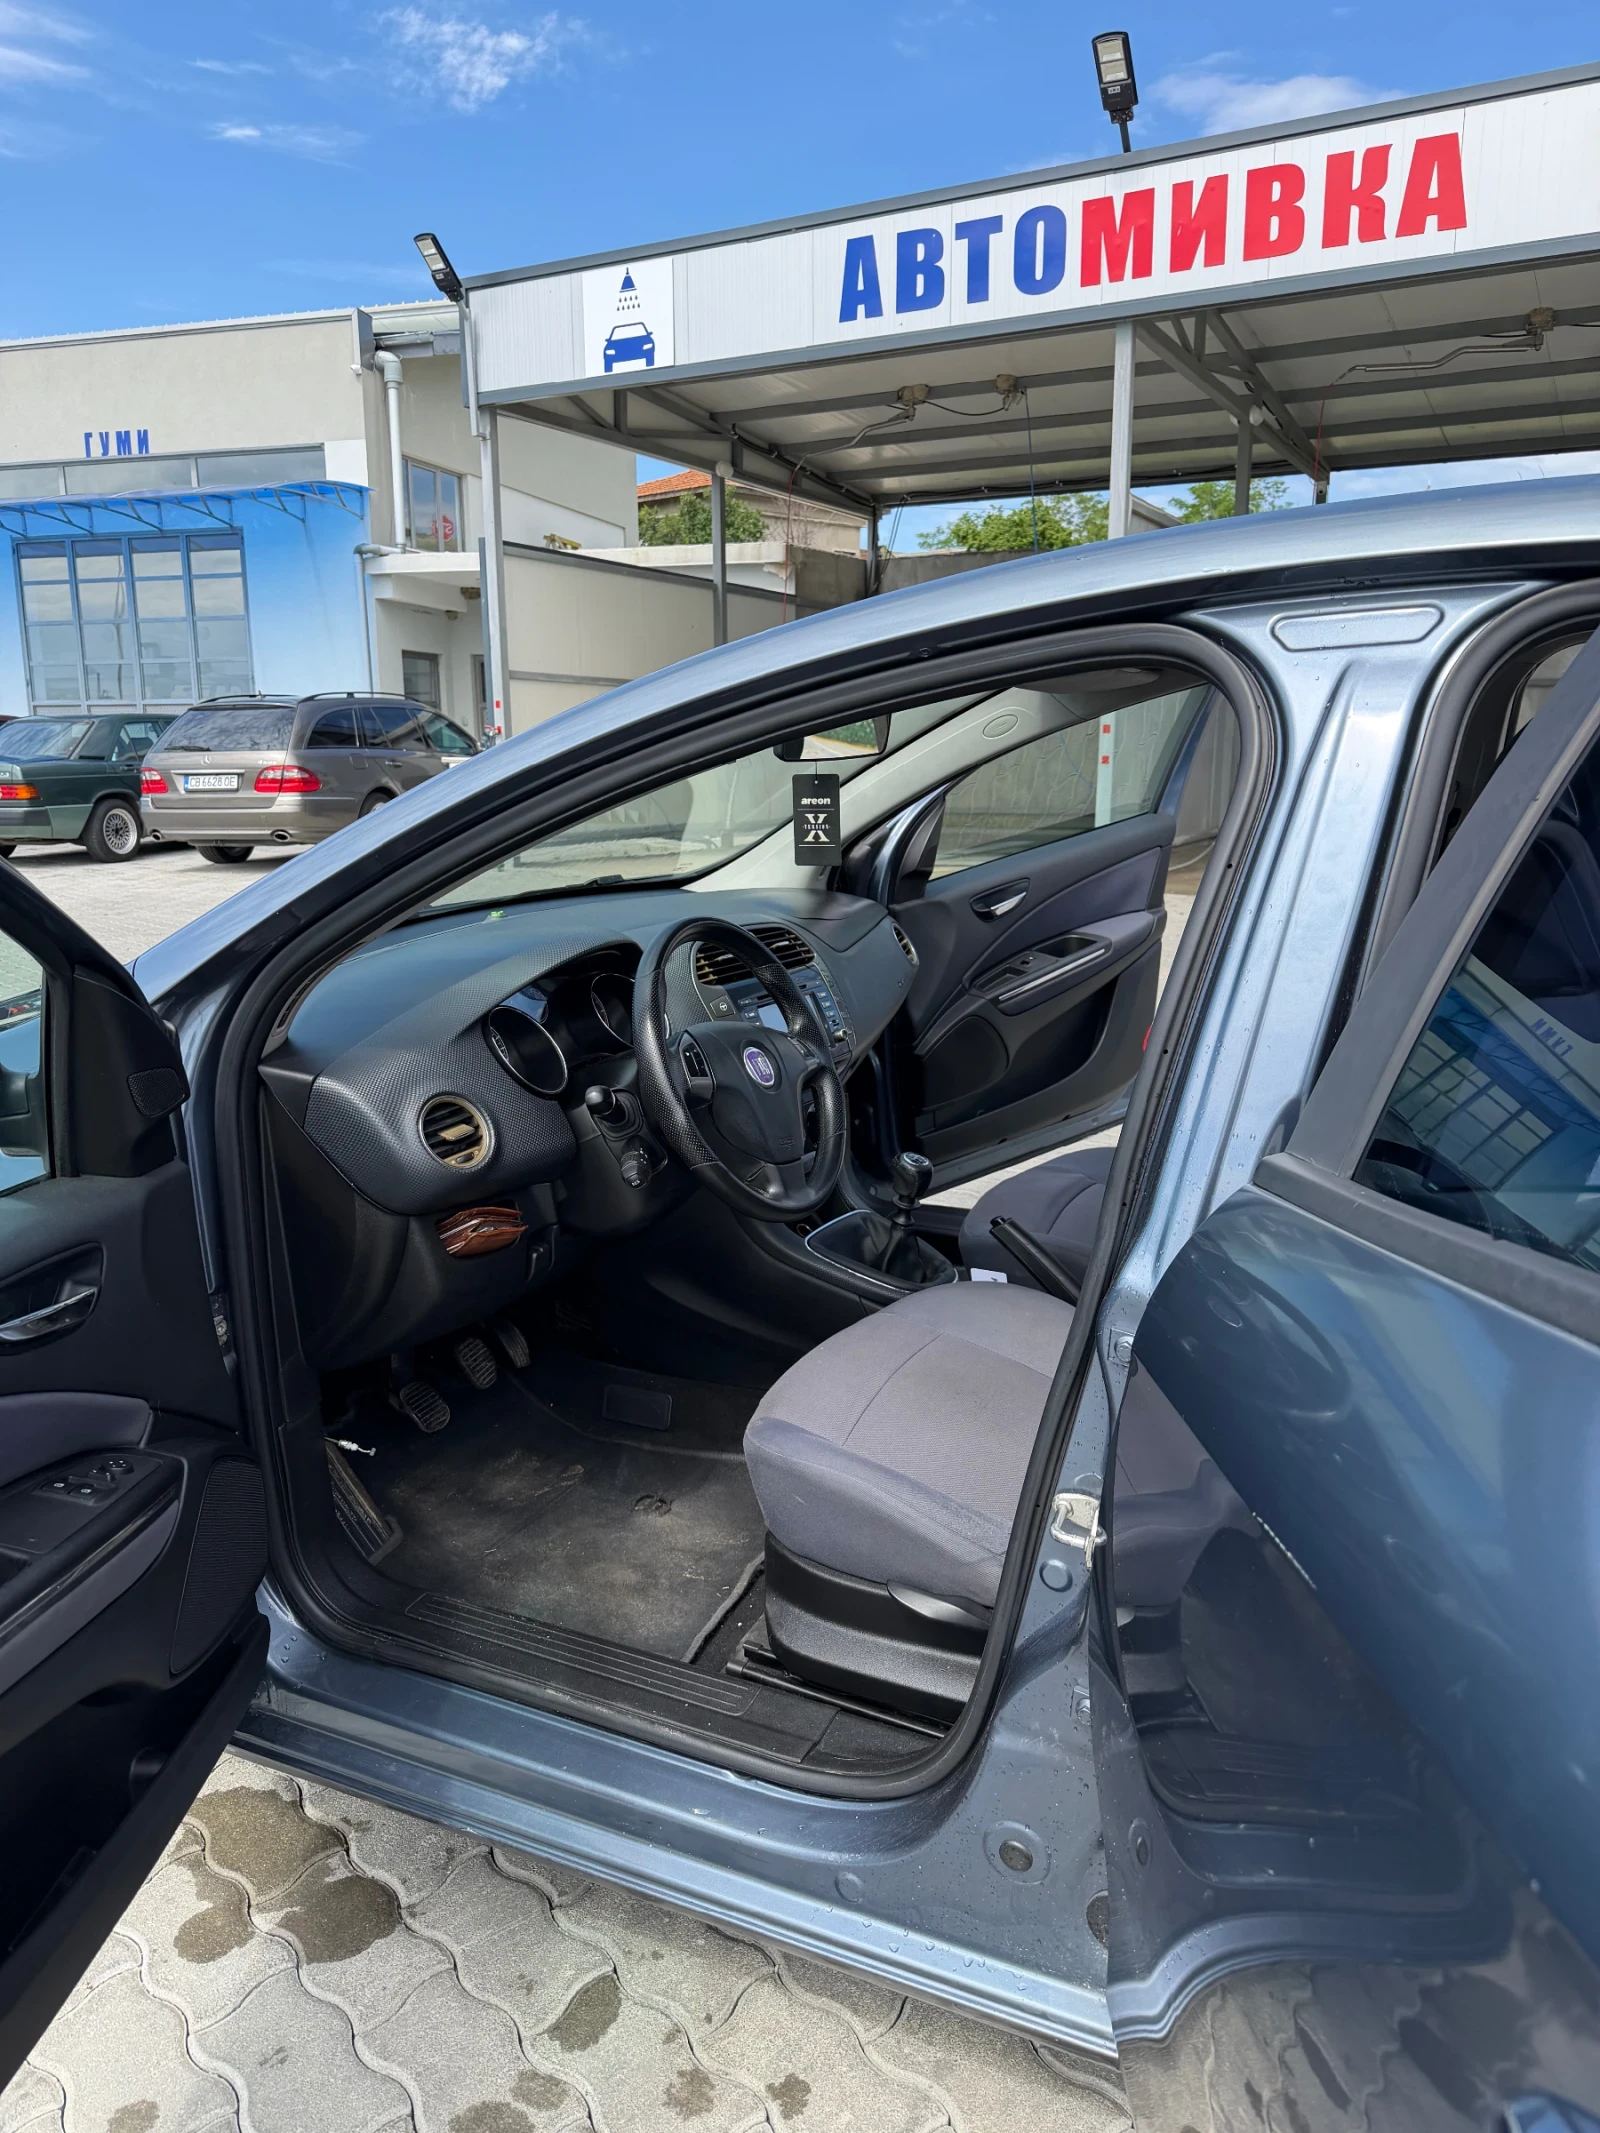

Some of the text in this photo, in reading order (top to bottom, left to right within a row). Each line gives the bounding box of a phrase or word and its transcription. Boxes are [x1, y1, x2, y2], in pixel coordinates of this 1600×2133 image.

[838, 132, 1468, 323] АВТОМИВКА
[83, 428, 150, 459] ГУМИ
[801, 797, 831, 805] areon
